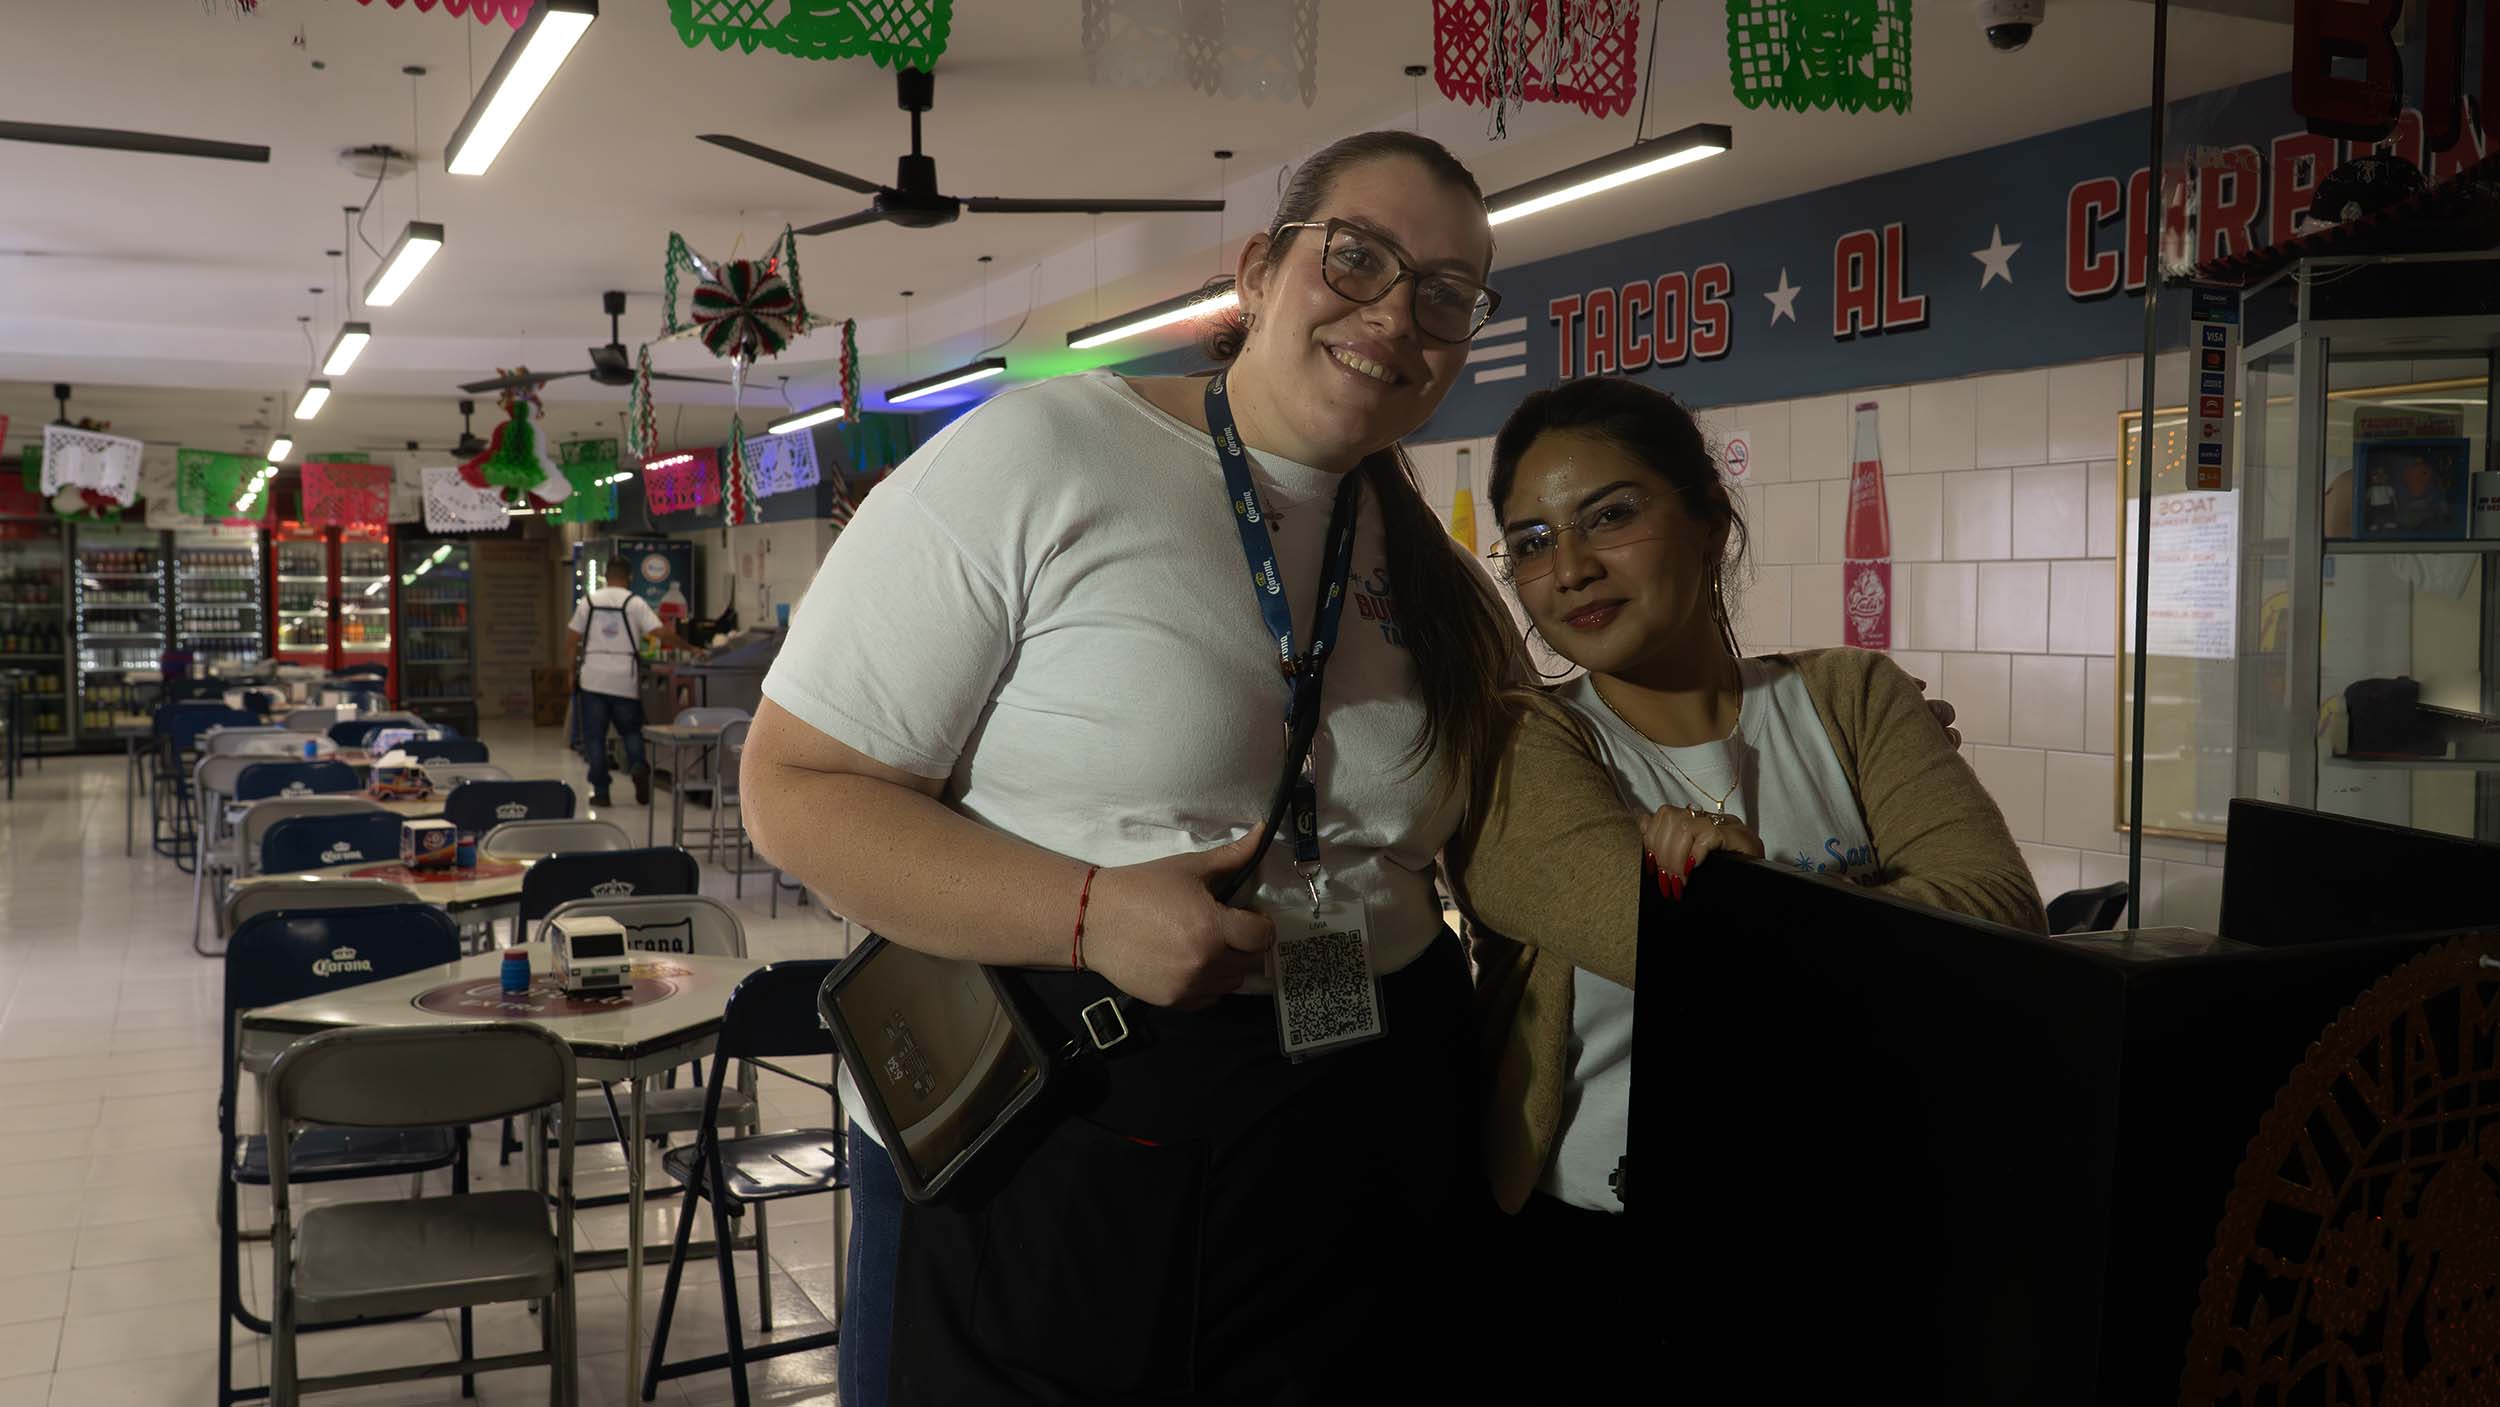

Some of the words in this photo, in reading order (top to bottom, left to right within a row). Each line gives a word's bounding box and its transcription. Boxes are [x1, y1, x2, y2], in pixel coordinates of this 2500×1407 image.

[1549, 262, 1733, 379] TACOS
[1832, 221, 1928, 340] AL
[2206, 331, 2224, 343] VISA
[1225, 424, 1241, 457] Corona
[1243, 489, 1260, 524] Corona
[1262, 558, 1281, 596] Corona
[1279, 633, 1291, 663] rona
[311, 956, 374, 978] Corona
